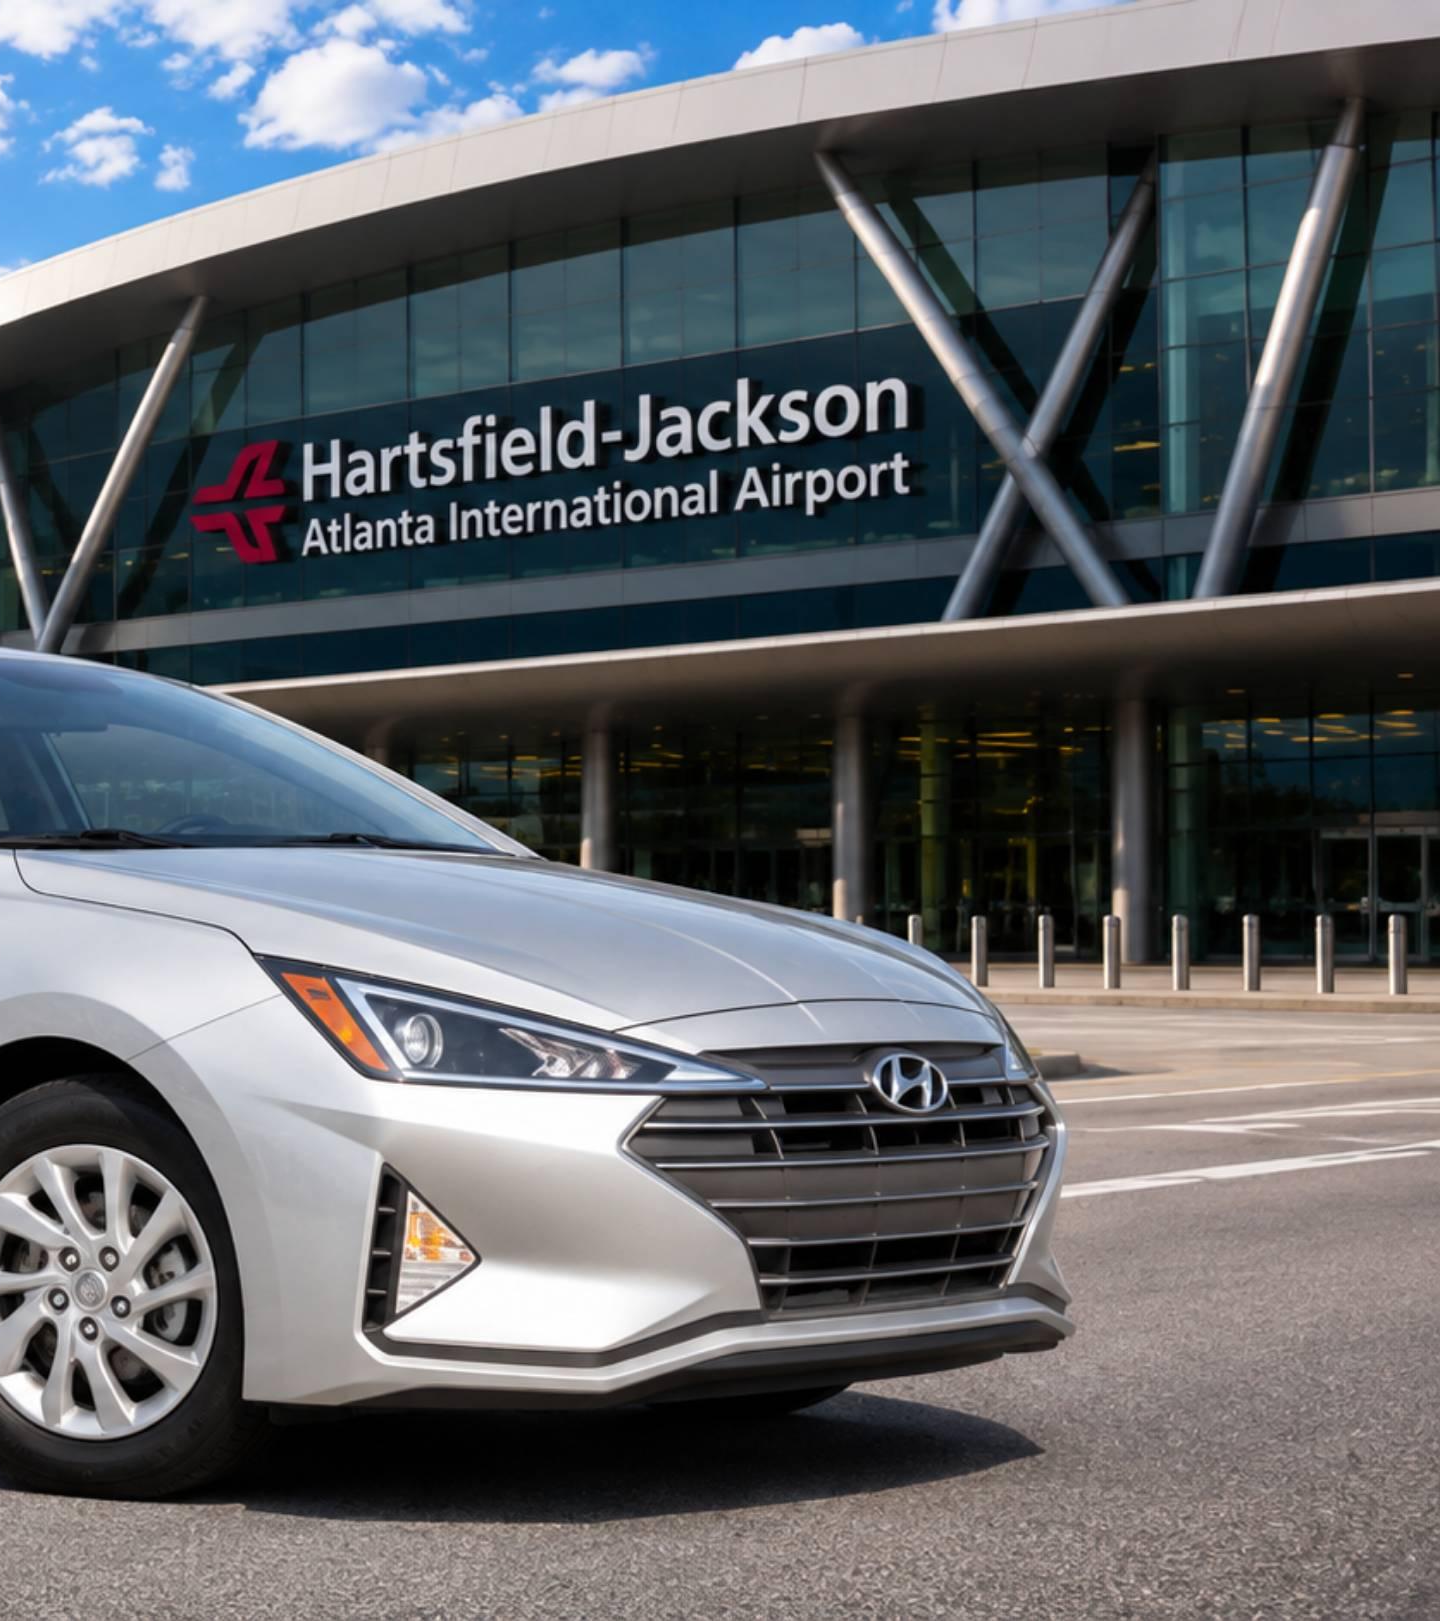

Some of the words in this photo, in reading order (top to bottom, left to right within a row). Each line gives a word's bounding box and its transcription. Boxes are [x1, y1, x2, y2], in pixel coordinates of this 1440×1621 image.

[302, 376, 909, 502] Hartsfield-Jackson
[301, 510, 435, 557] Atlanta
[449, 468, 719, 542] International
[733, 451, 911, 517] Airport
